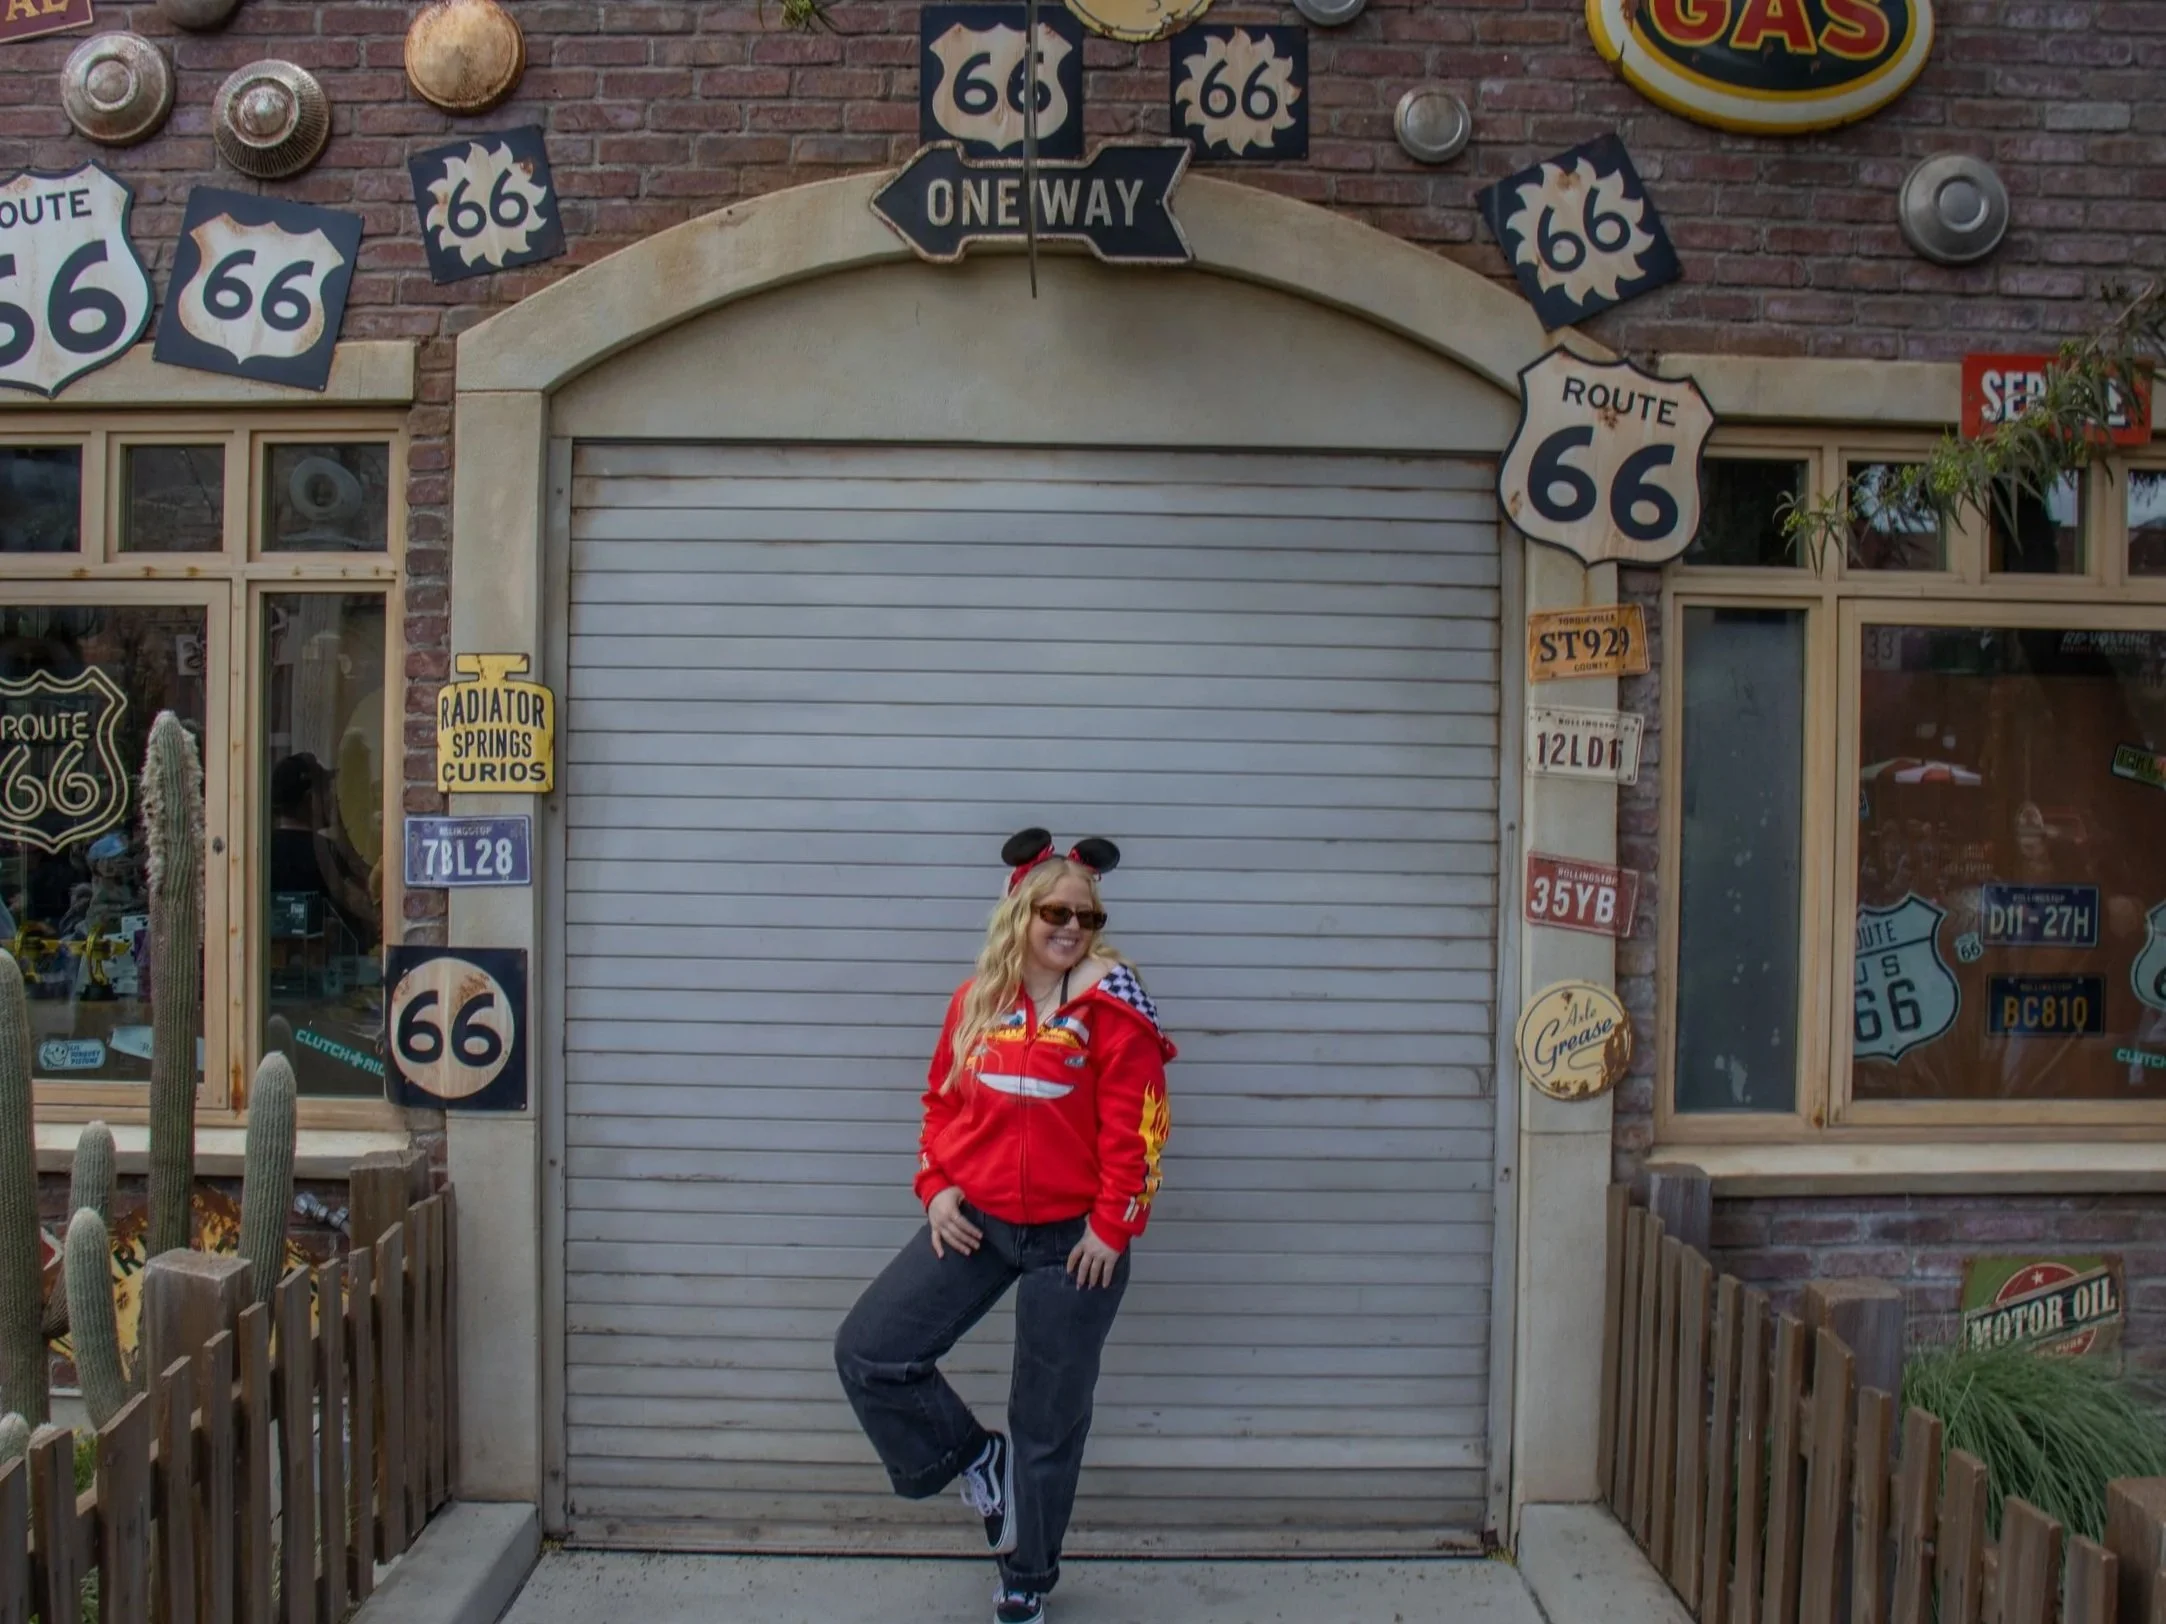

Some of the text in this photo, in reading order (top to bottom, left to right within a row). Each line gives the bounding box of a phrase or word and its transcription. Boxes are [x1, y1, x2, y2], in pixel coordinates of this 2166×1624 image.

[1650, 0, 1890, 60] GAS
[952, 51, 1052, 116] 66
[1200, 59, 1278, 120] 66
[0, 188, 92, 229] OUTE
[446, 167, 530, 238] 66
[926, 178, 1144, 227] ONE WAY
[1536, 186, 1632, 273] 66
[203, 249, 315, 332] 66
[1562, 376, 1678, 427] ROUTE
[1981, 370, 2129, 428] SERE
[1527, 425, 1679, 542] 66
[1539, 626, 1630, 663] ST929
[1574, 661, 1609, 673] COUNTY
[1, 711, 90, 741] ROUTE
[441, 687, 545, 731] RADIATOR
[452, 728, 532, 759] SPRINGS
[0, 740, 100, 821] 66
[442, 762, 546, 783] CURIOS
[422, 837, 513, 877] 7BL28
[1530, 876, 1617, 925] 35YB
[1857, 919, 1897, 950] UTE
[397, 989, 503, 1068] 66
[1855, 977, 1923, 1043] 66
[295, 1028, 352, 1063] CLUTCH
[1534, 1016, 1614, 1078] Grease
[1970, 1277, 2116, 1353] MOTOR OIL
